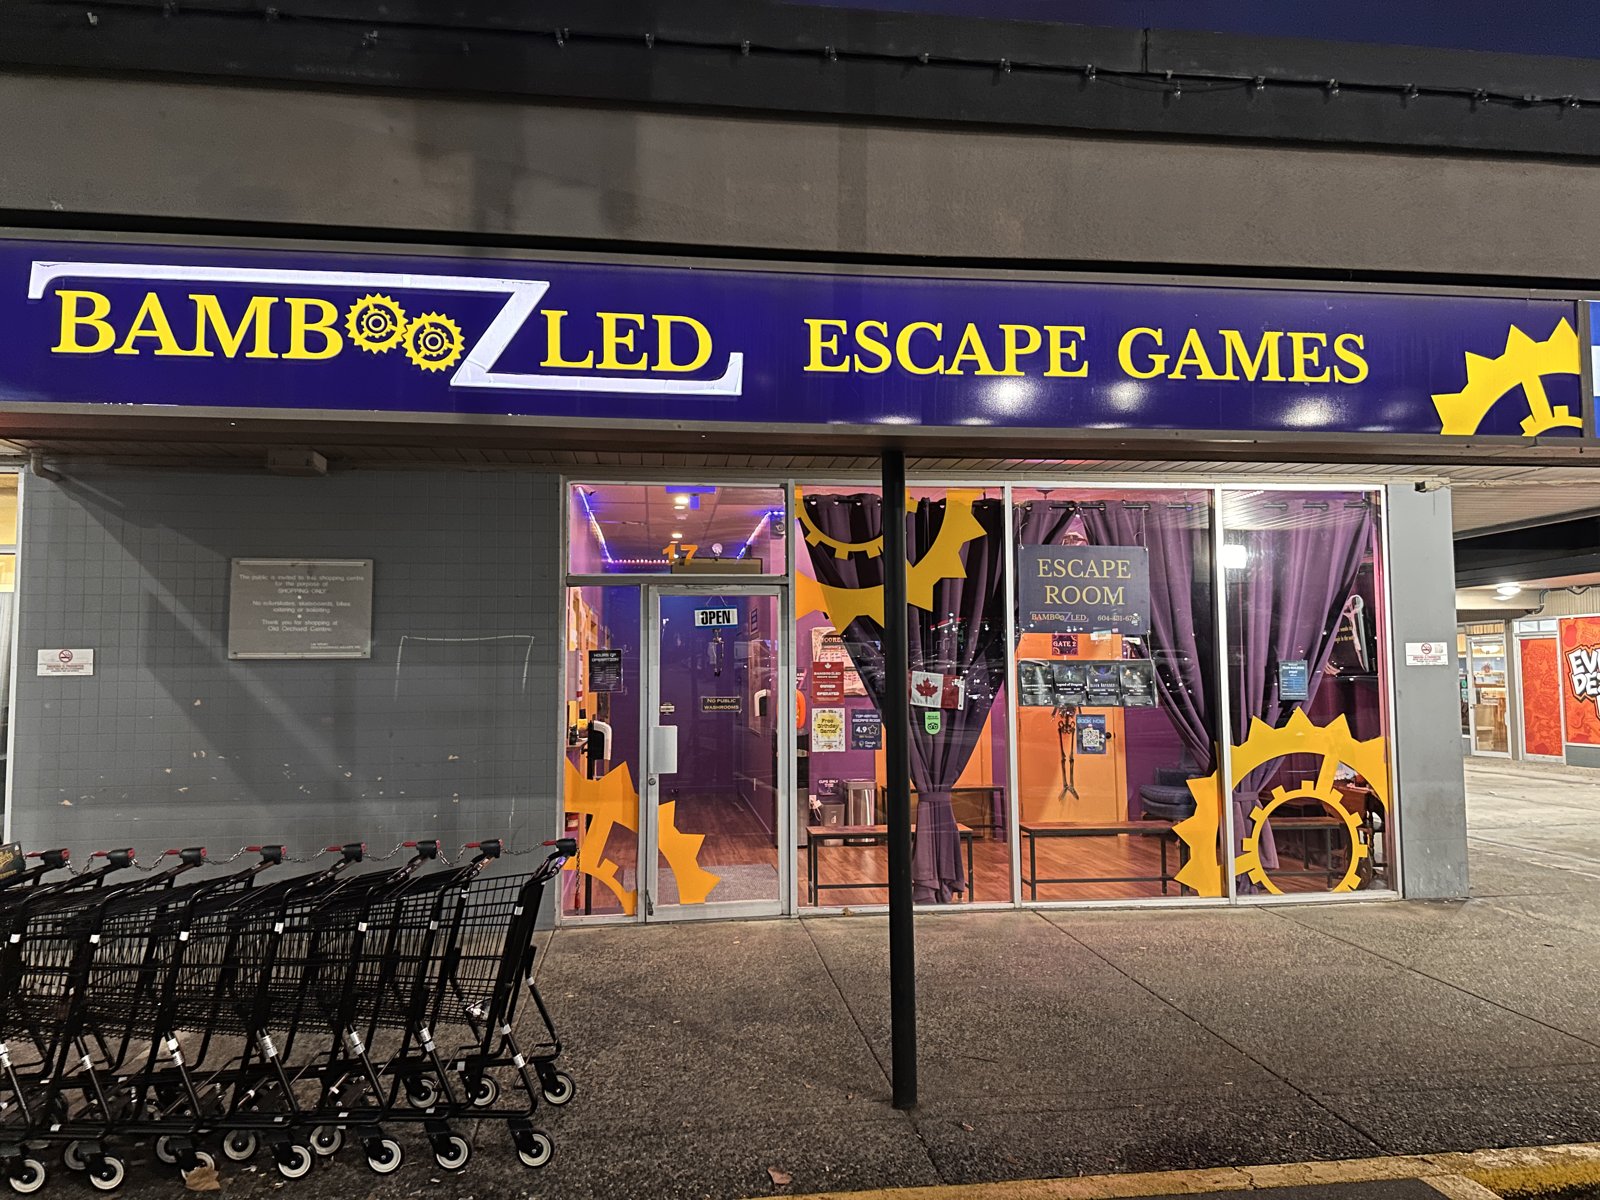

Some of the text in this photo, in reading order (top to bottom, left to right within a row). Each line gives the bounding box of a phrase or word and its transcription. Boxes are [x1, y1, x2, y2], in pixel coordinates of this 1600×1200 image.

[803, 318, 1090, 379] ESCAPE
[1117, 327, 1370, 384] GAMES
[662, 543, 699, 566] 17
[1036, 558, 1132, 579] ESCAPE
[1044, 585, 1125, 605] ROOM
[700, 610, 731, 625] OPEN
[1568, 648, 1600, 676] EV
[1571, 671, 1600, 697] DE
[855, 725, 868, 734] 4.9
